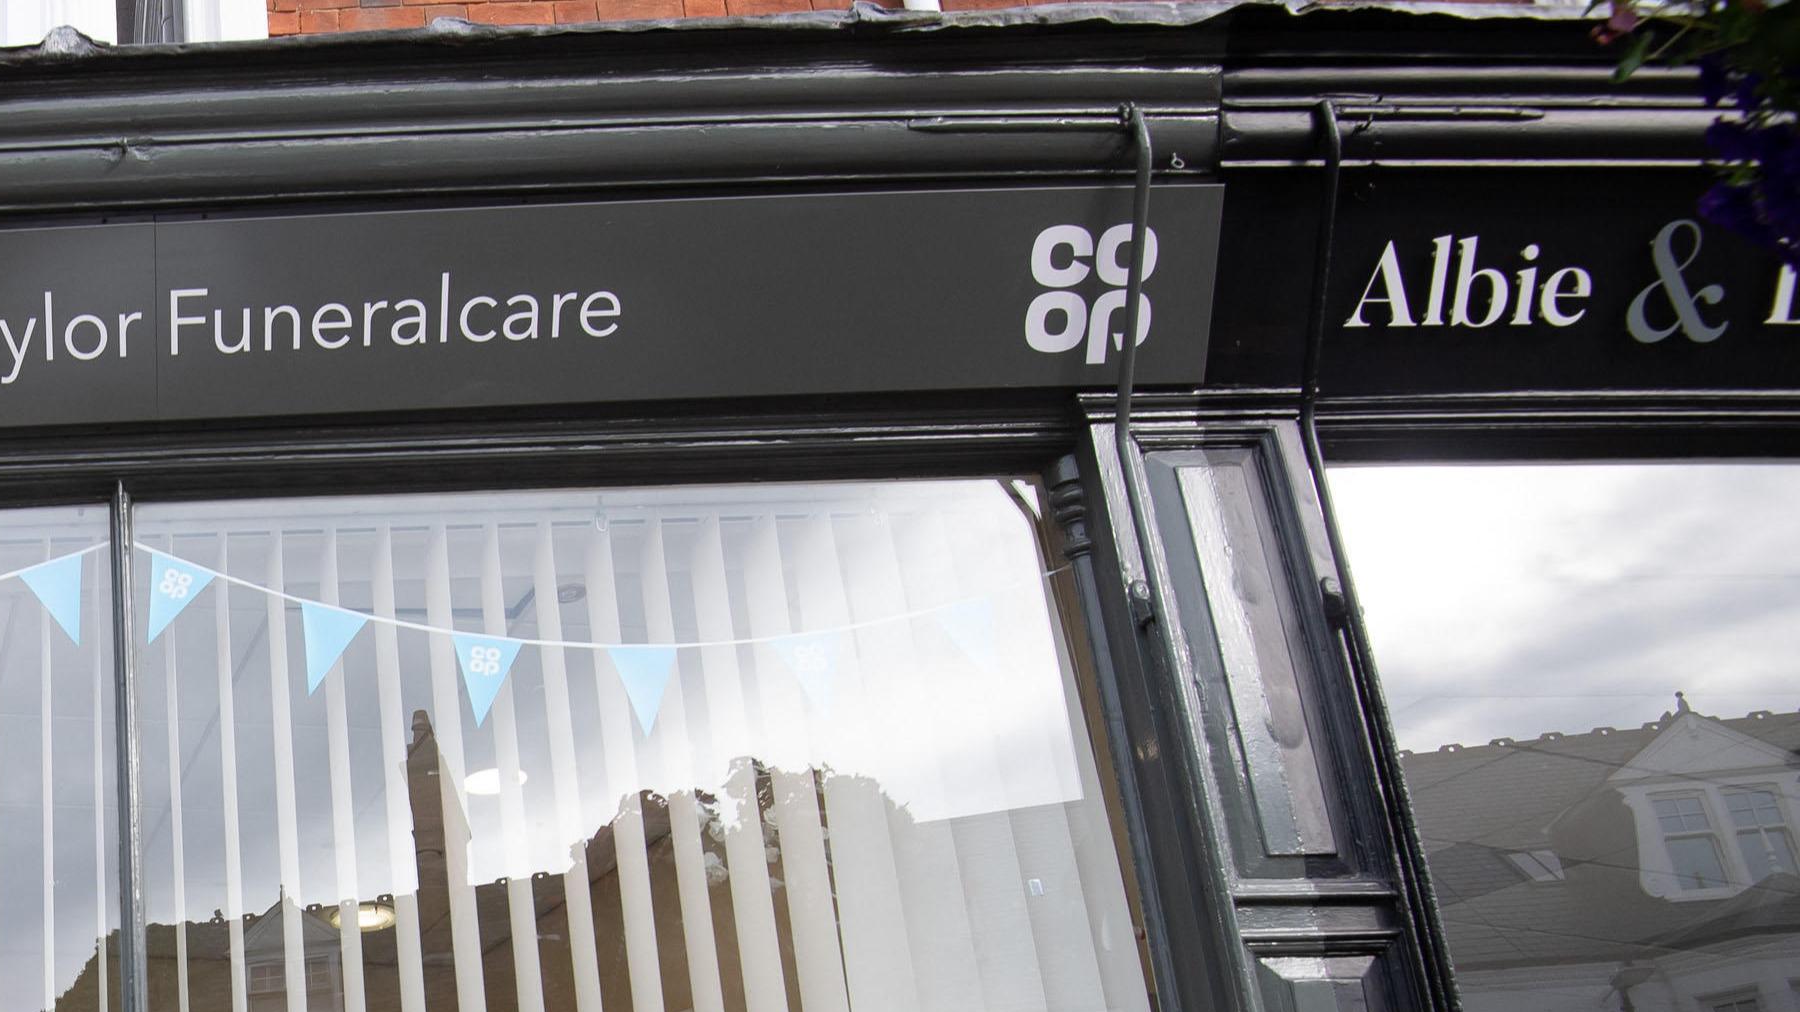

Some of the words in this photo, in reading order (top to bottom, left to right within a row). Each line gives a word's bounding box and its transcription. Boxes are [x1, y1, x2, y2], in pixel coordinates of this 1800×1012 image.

[169, 273, 623, 357] Funeralcare
[1343, 234, 1593, 329] Albie
[1626, 219, 1728, 345] &
